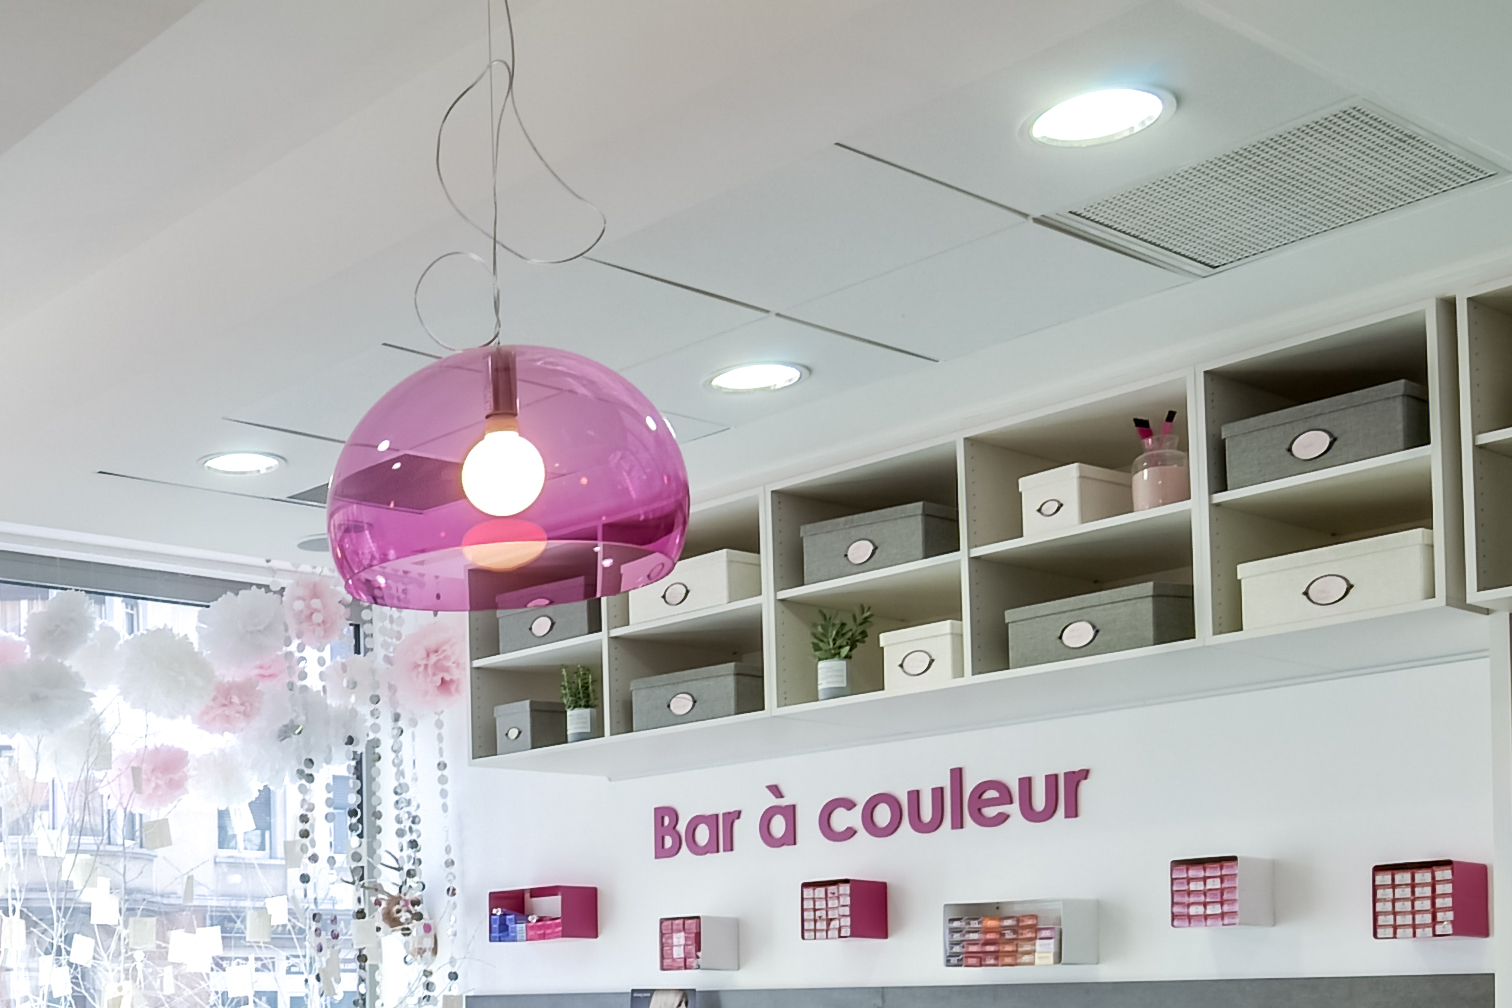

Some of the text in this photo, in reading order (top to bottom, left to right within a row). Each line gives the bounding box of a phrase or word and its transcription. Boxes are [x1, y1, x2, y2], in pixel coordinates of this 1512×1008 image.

[653, 767, 1090, 859] Bar à couleur
